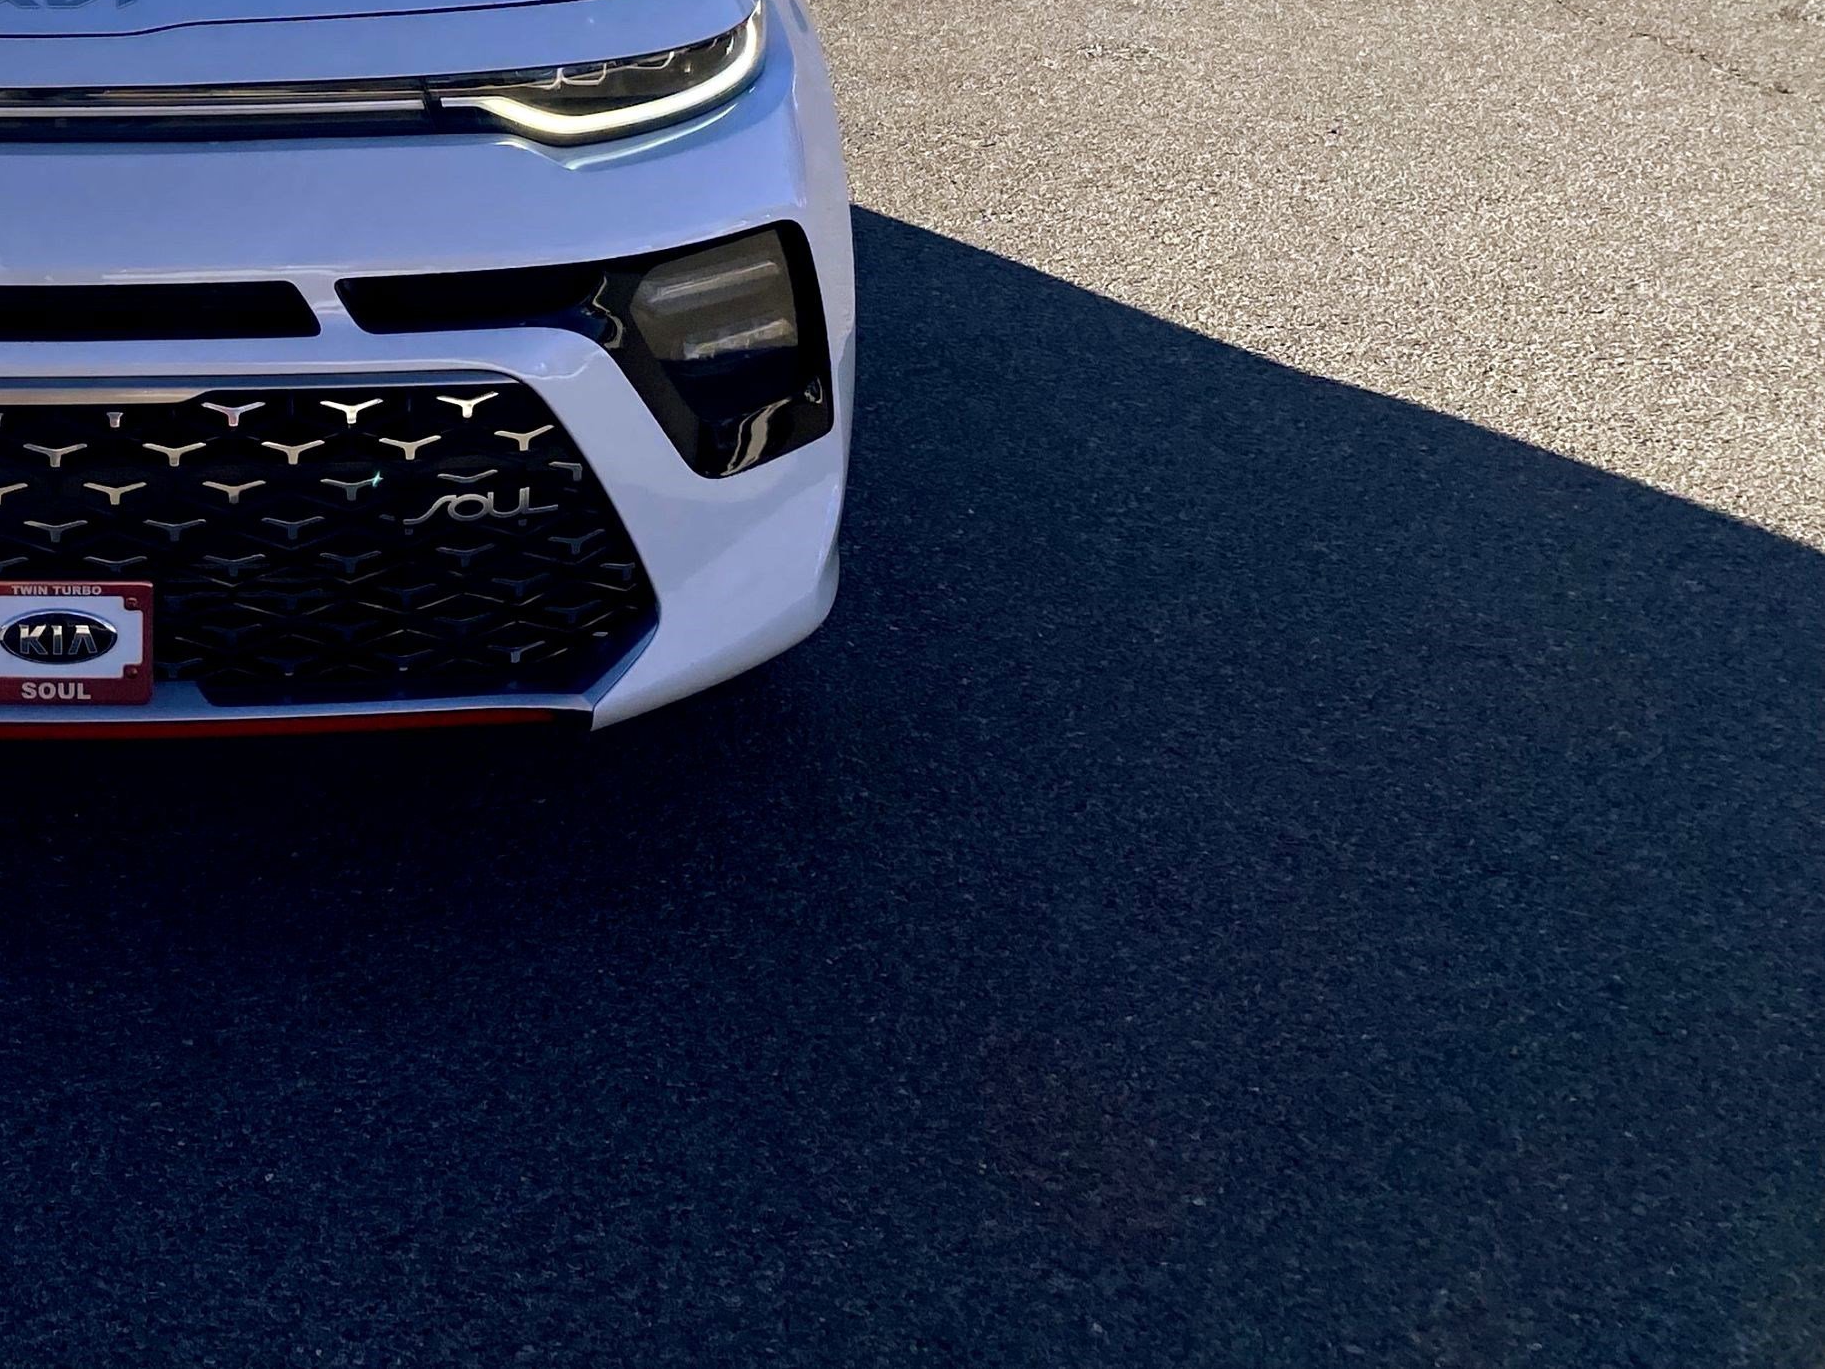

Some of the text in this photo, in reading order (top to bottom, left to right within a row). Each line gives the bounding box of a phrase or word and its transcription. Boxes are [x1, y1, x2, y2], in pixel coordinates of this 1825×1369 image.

[11, 585, 102, 595] TWIN TURBO
[18, 623, 98, 656] KIA
[21, 682, 91, 700] SOUL
